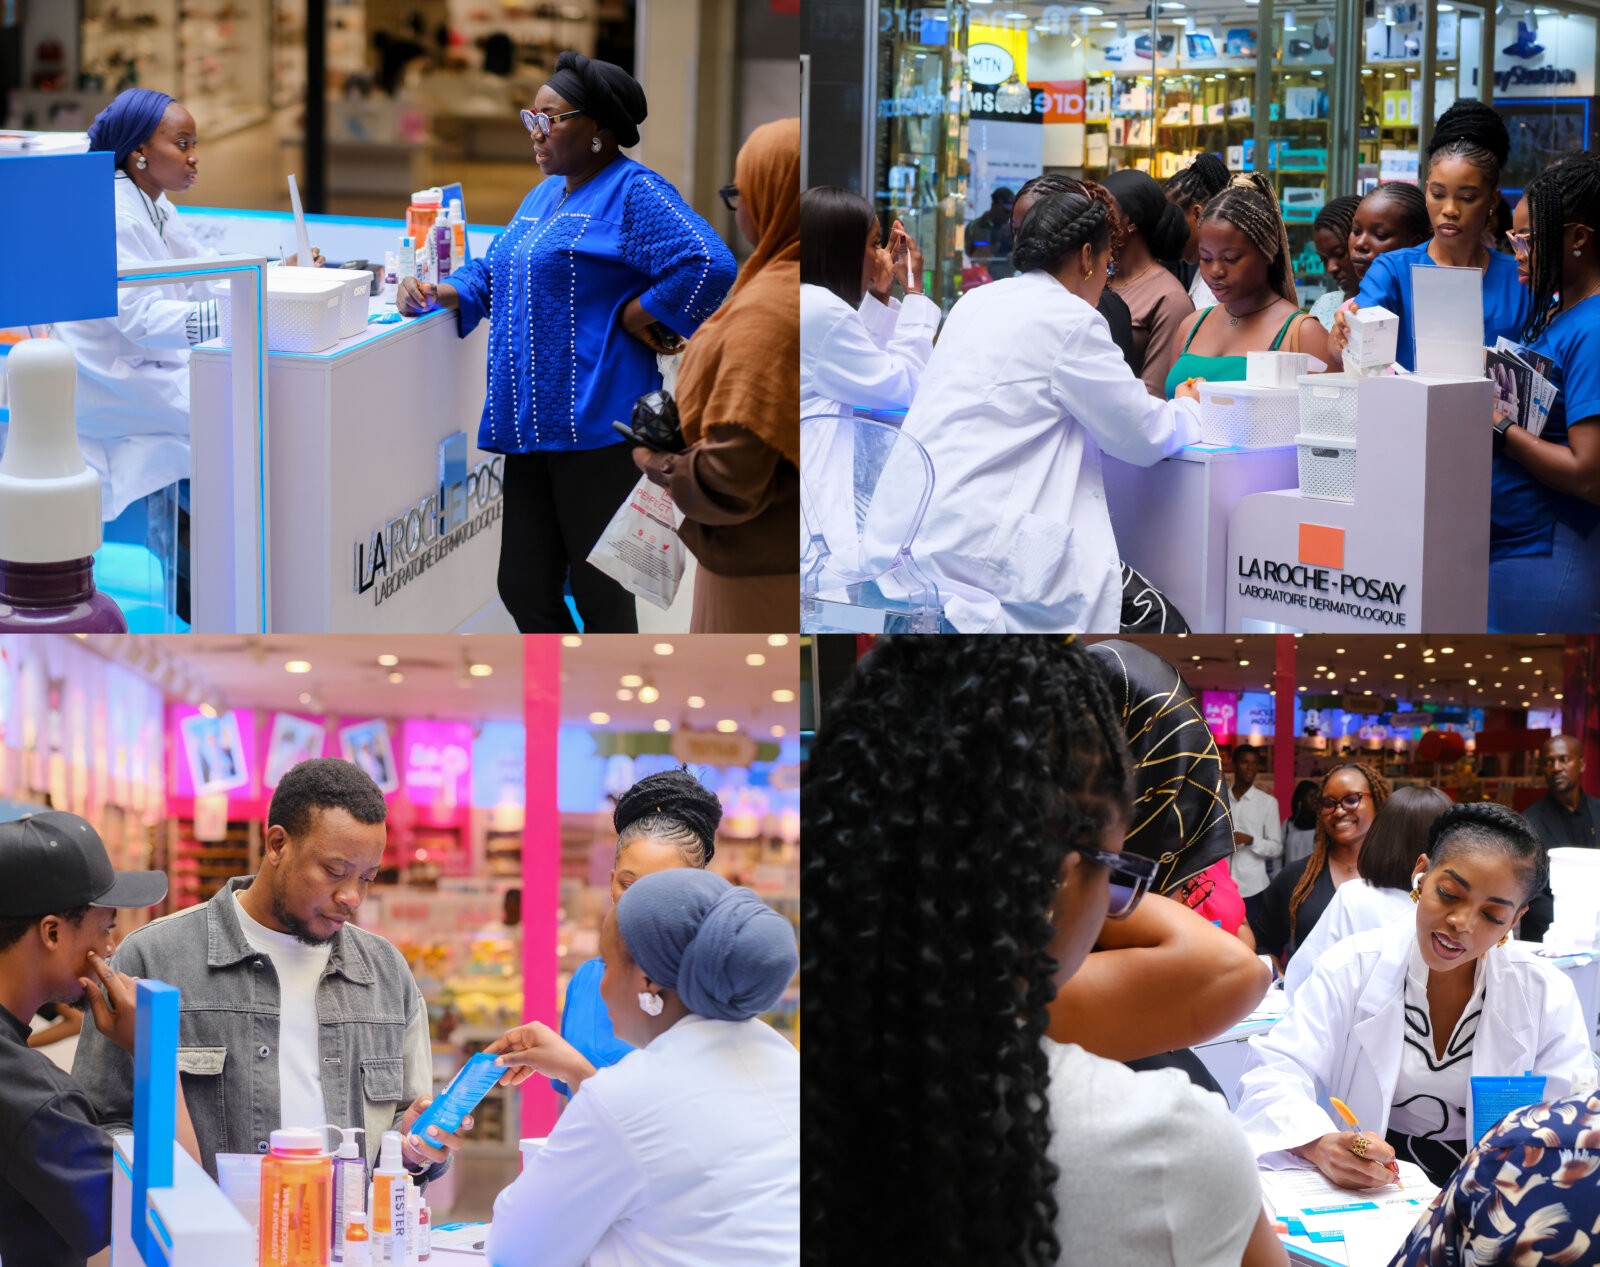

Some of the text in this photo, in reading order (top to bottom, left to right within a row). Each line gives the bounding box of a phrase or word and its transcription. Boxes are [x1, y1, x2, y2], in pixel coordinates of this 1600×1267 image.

[972, 57, 1001, 72] MTN
[354, 531, 387, 594] LA
[466, 456, 503, 510] POS
[374, 550, 435, 607] LABORATOIRE
[1239, 556, 1262, 580] LA
[1239, 583, 1406, 626] LABORATOIRE DERMATOLOGIQUE
[271, 1211, 279, 1260] EVERYDAY
[280, 1187, 291, 1266] SUNSCREEN DAY
[395, 1185, 405, 1236] TESTER
